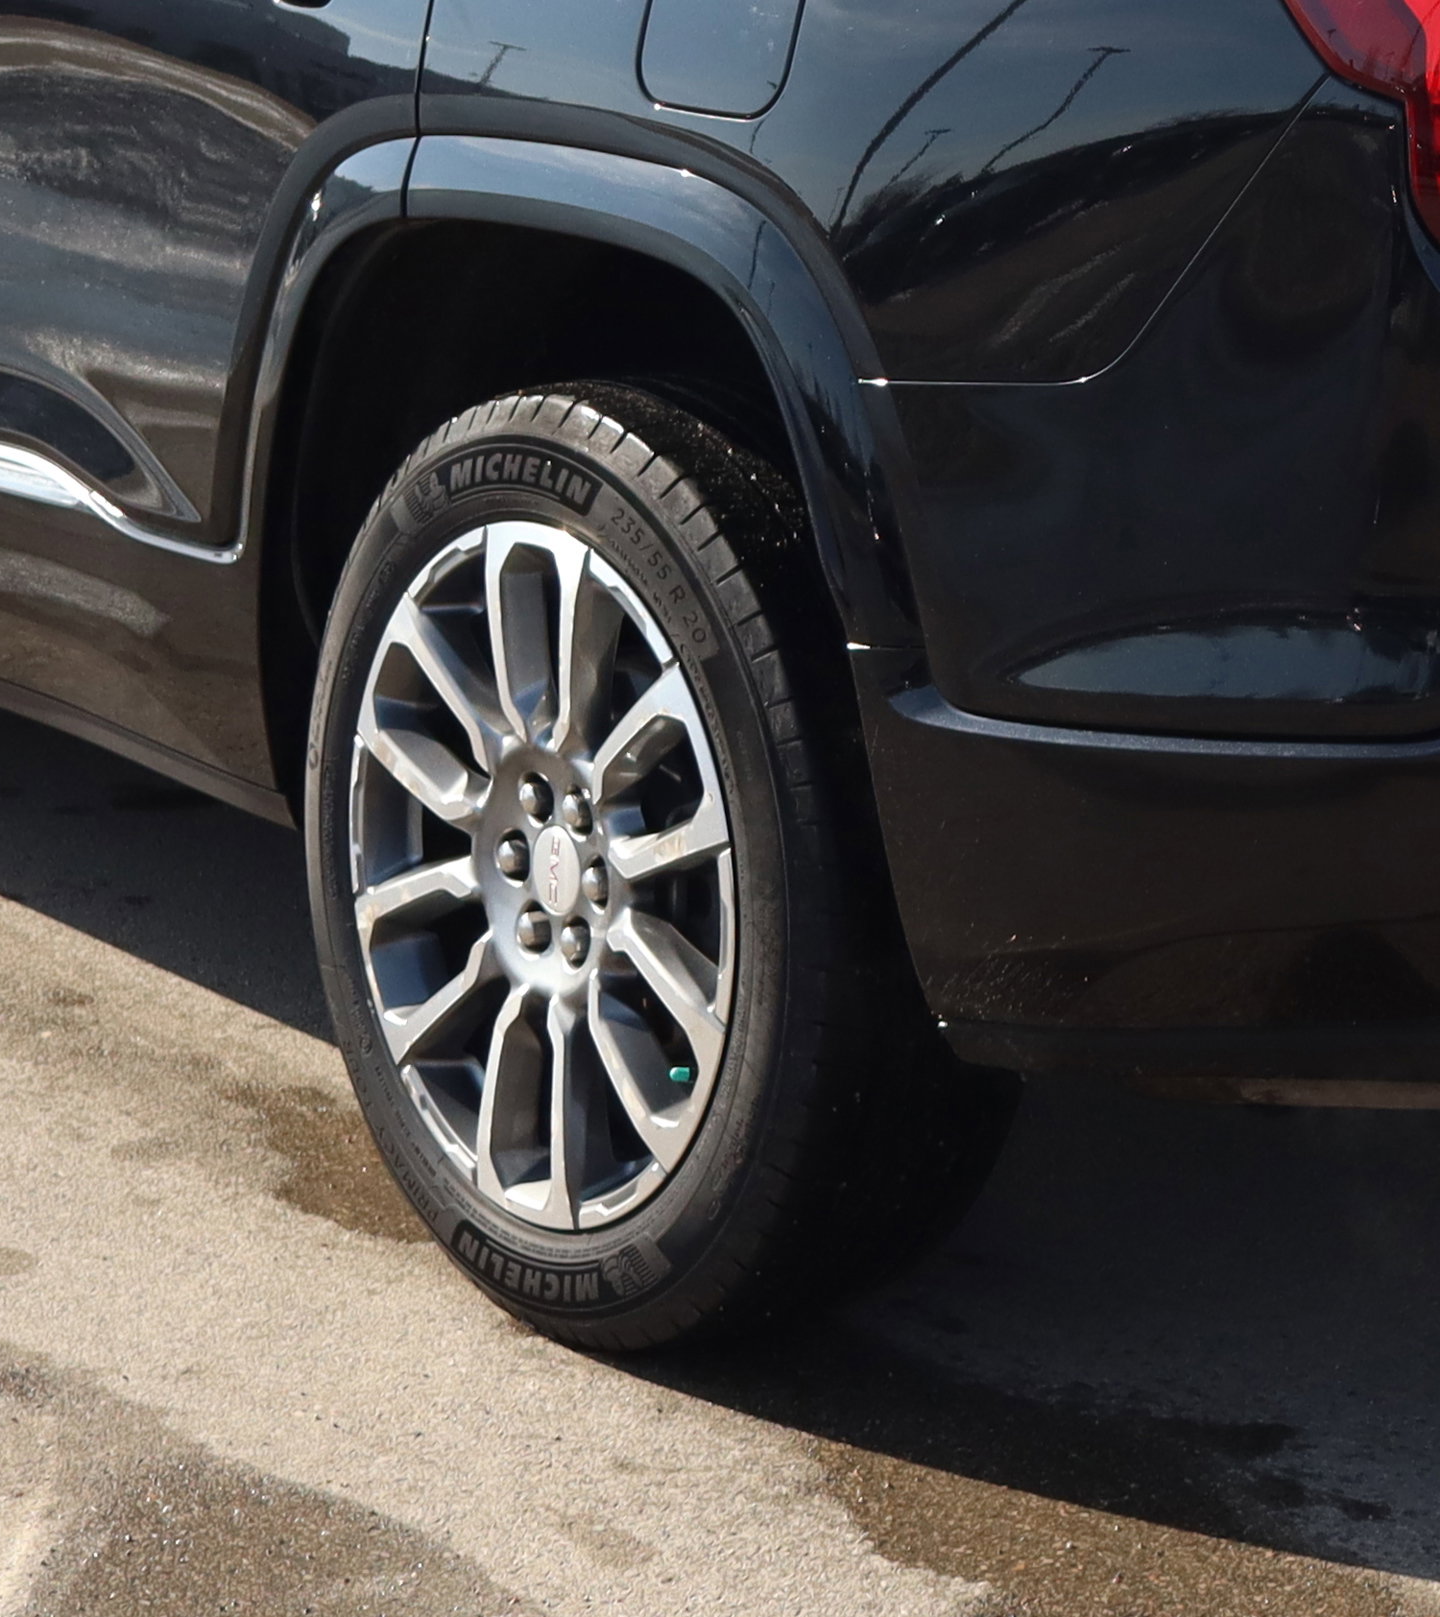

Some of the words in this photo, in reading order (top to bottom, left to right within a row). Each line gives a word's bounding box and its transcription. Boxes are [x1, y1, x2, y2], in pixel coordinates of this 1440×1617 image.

[449, 452, 593, 507] MICHELIN
[610, 507, 673, 581] 235/55
[668, 584, 687, 604] R
[682, 612, 707, 644] 20
[375, 1123, 439, 1223] PRIMACY
[458, 1235, 601, 1306] MICHELIN
